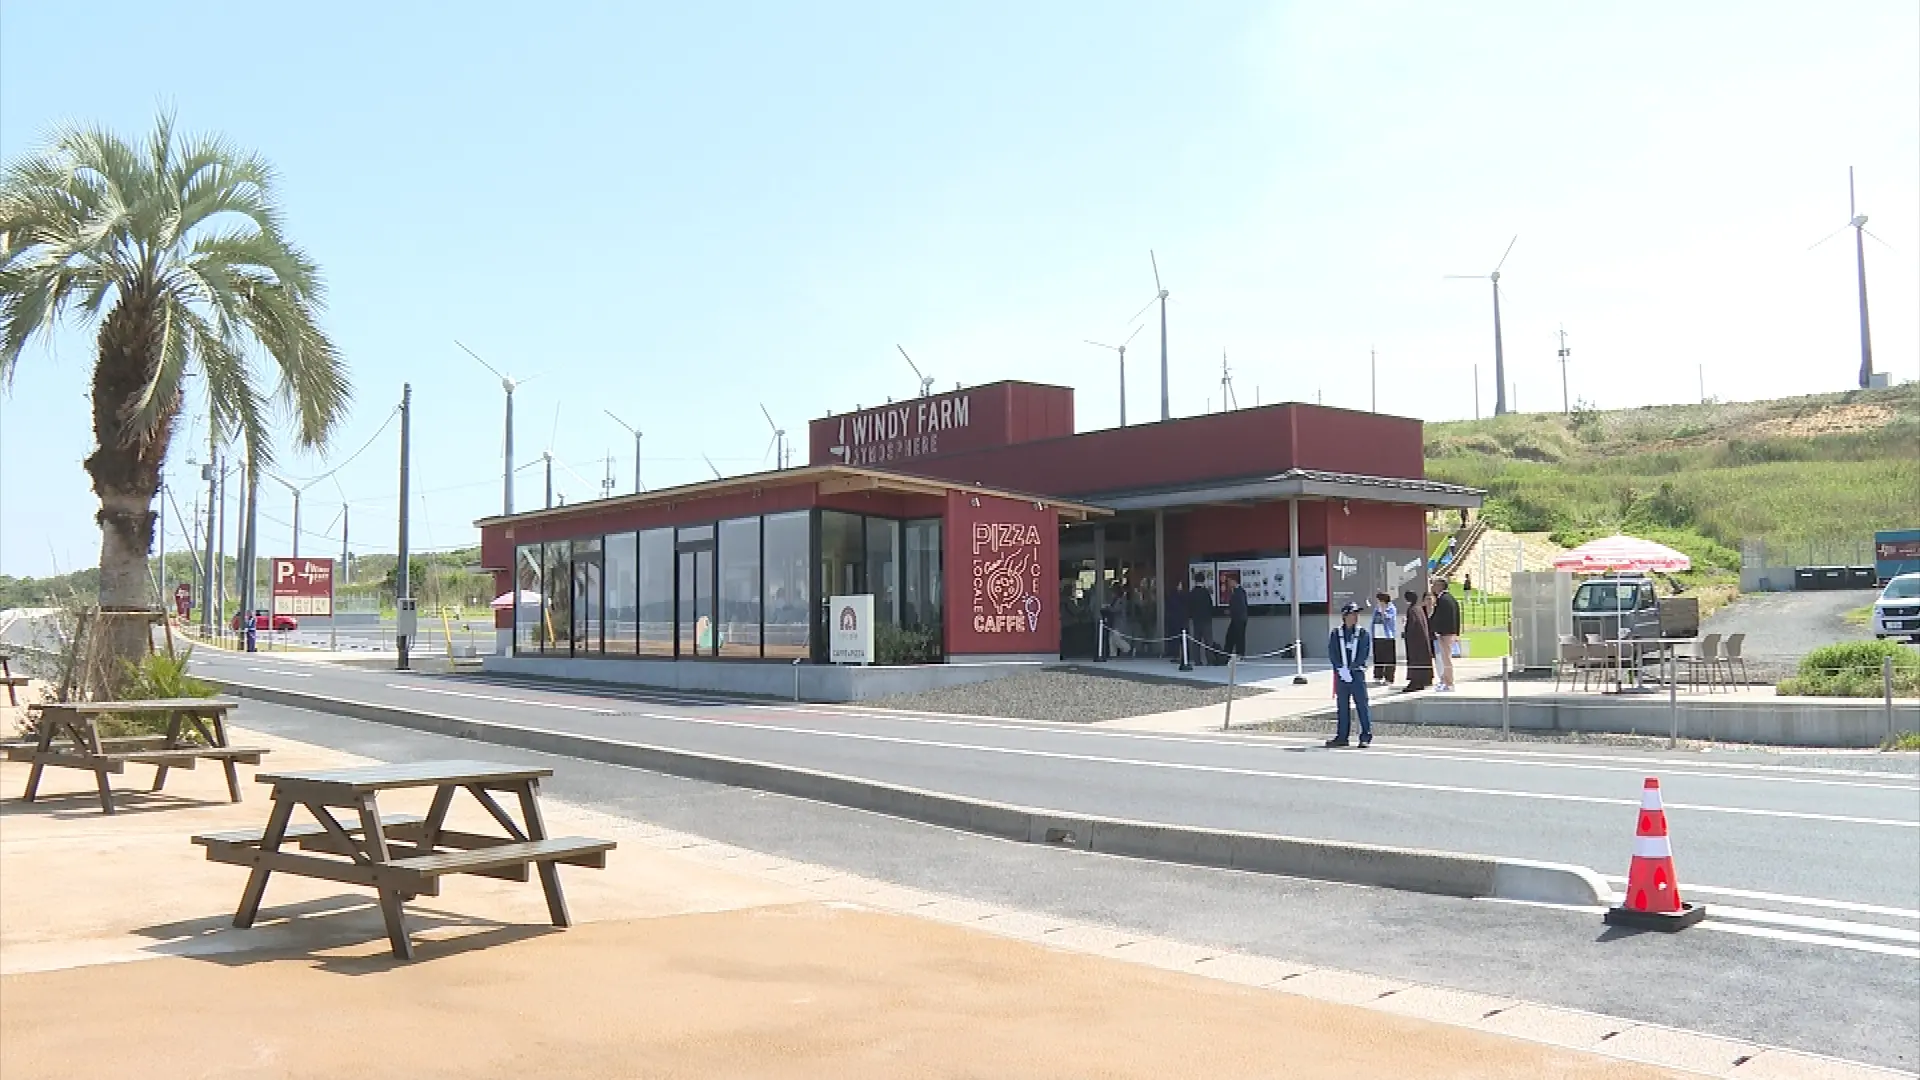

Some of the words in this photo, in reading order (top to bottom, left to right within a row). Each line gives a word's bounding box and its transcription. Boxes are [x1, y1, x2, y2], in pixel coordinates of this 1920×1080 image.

[852, 407, 910, 446] WINDY
[917, 395, 969, 435] FARM
[972, 522, 1041, 555] PIZZA
[973, 559, 984, 613] LOCALE
[1031, 547, 1041, 594] ICE
